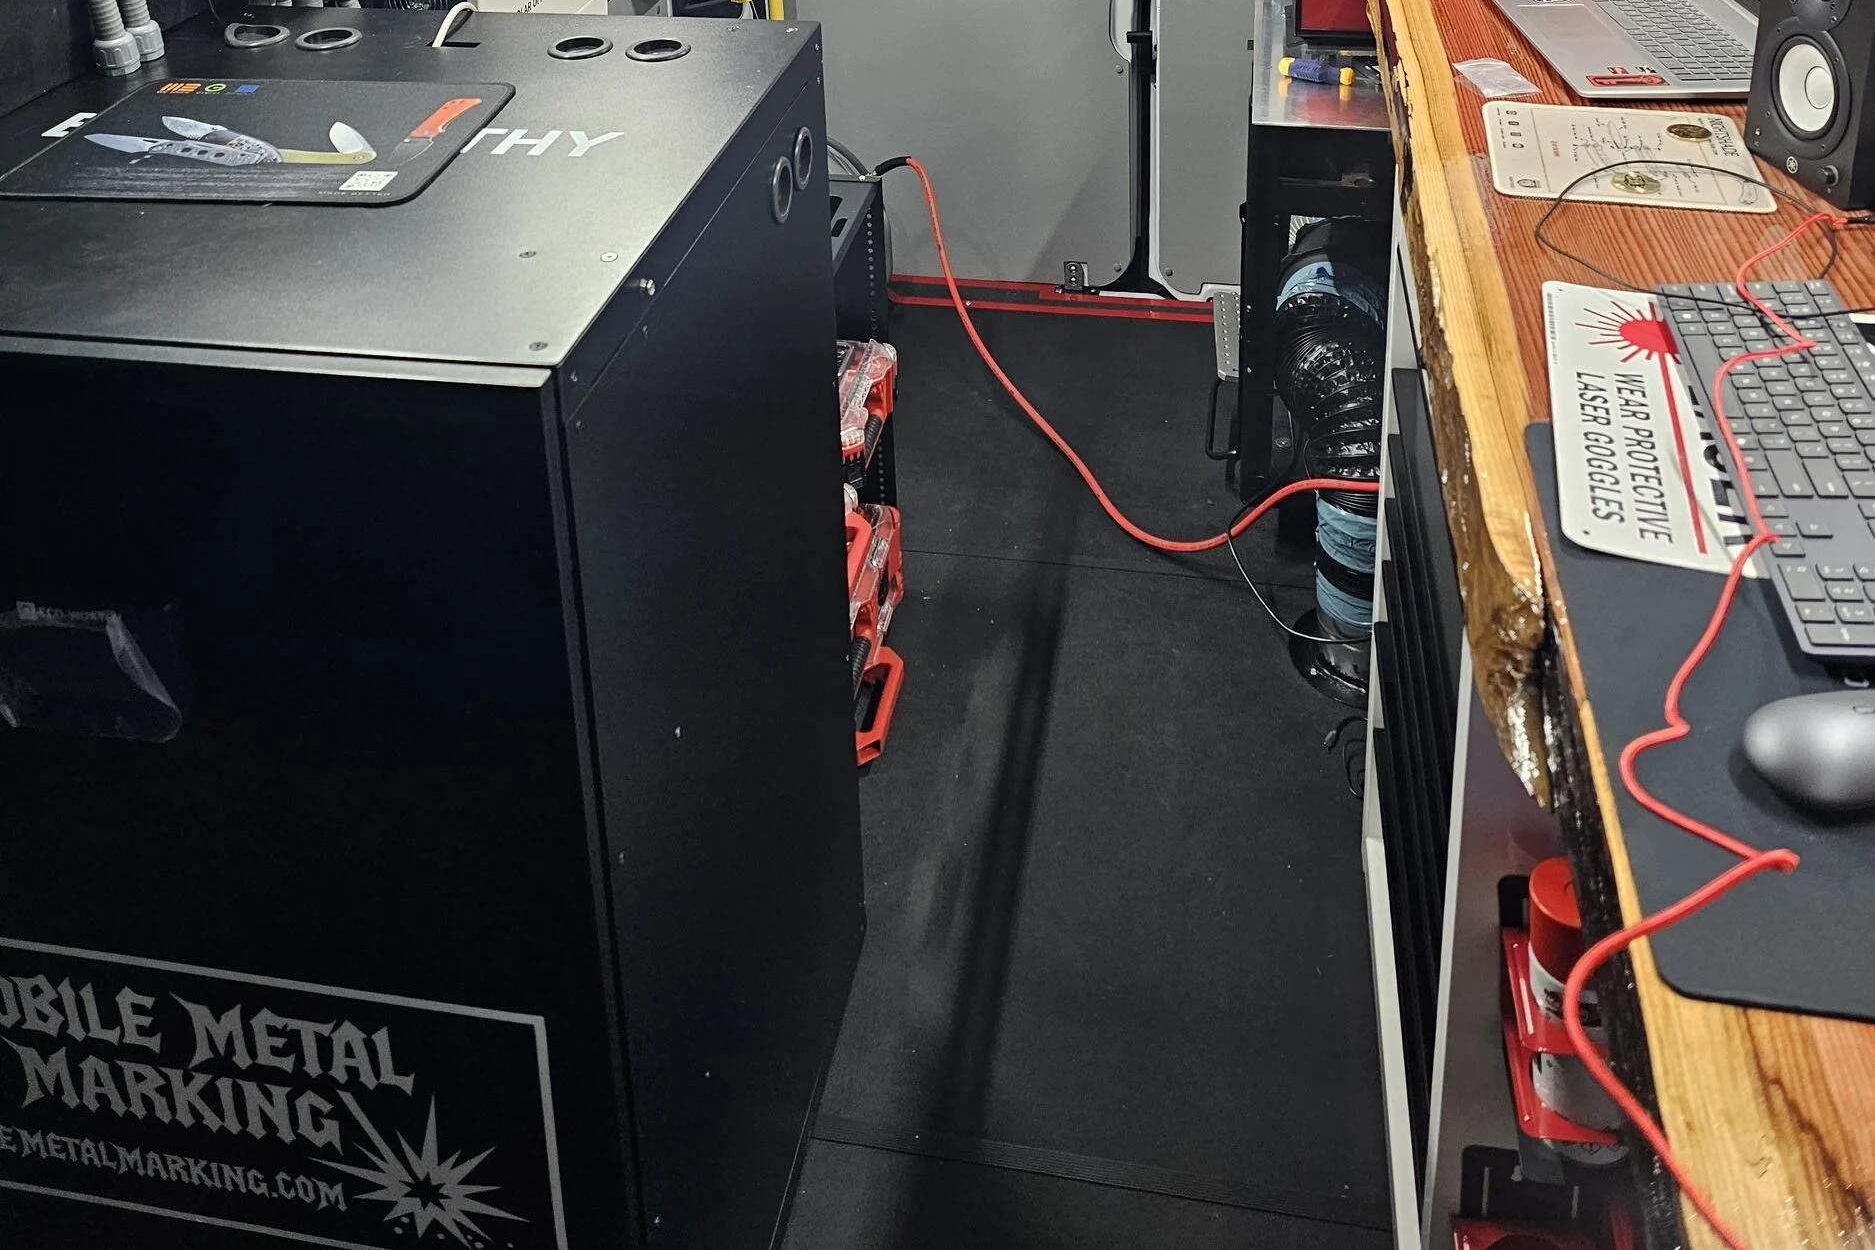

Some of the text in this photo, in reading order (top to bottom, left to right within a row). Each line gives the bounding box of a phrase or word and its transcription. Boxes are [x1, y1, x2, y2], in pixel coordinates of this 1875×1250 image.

[1576, 370, 1625, 525] LASER GOGGLES
[1614, 372, 1673, 545] WEAR PROTECTIVE
[0, 973, 415, 1096] OBILE METAL
[0, 1034, 343, 1156] MARKING
